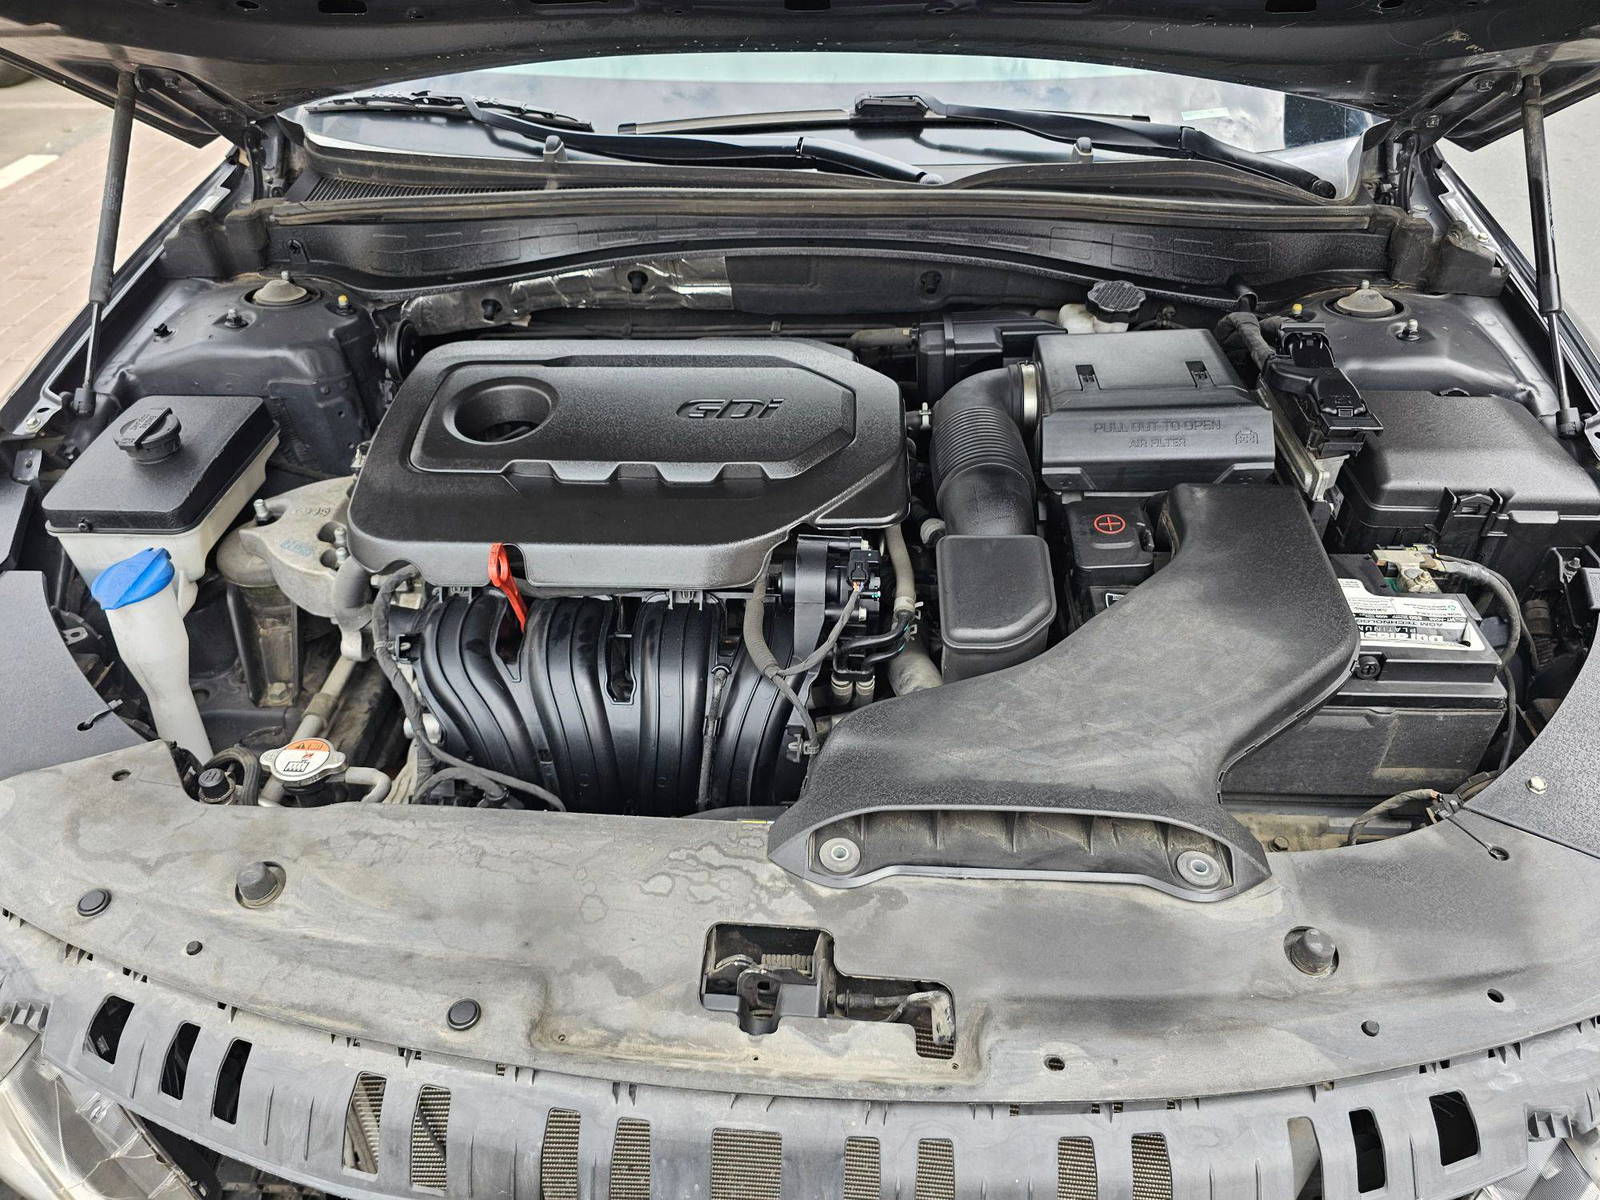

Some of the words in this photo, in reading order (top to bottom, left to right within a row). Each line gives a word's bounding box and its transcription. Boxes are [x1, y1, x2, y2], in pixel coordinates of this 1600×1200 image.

[1093, 422, 1128, 433] PULL
[1131, 421, 1159, 432] OUT
[1161, 420, 1181, 431] TO
[1183, 419, 1222, 431] OPEN
[1129, 437, 1148, 448] AIR
[1150, 436, 1187, 448] FILTER
[1356, 618, 1416, 626] TECHNOLOG
